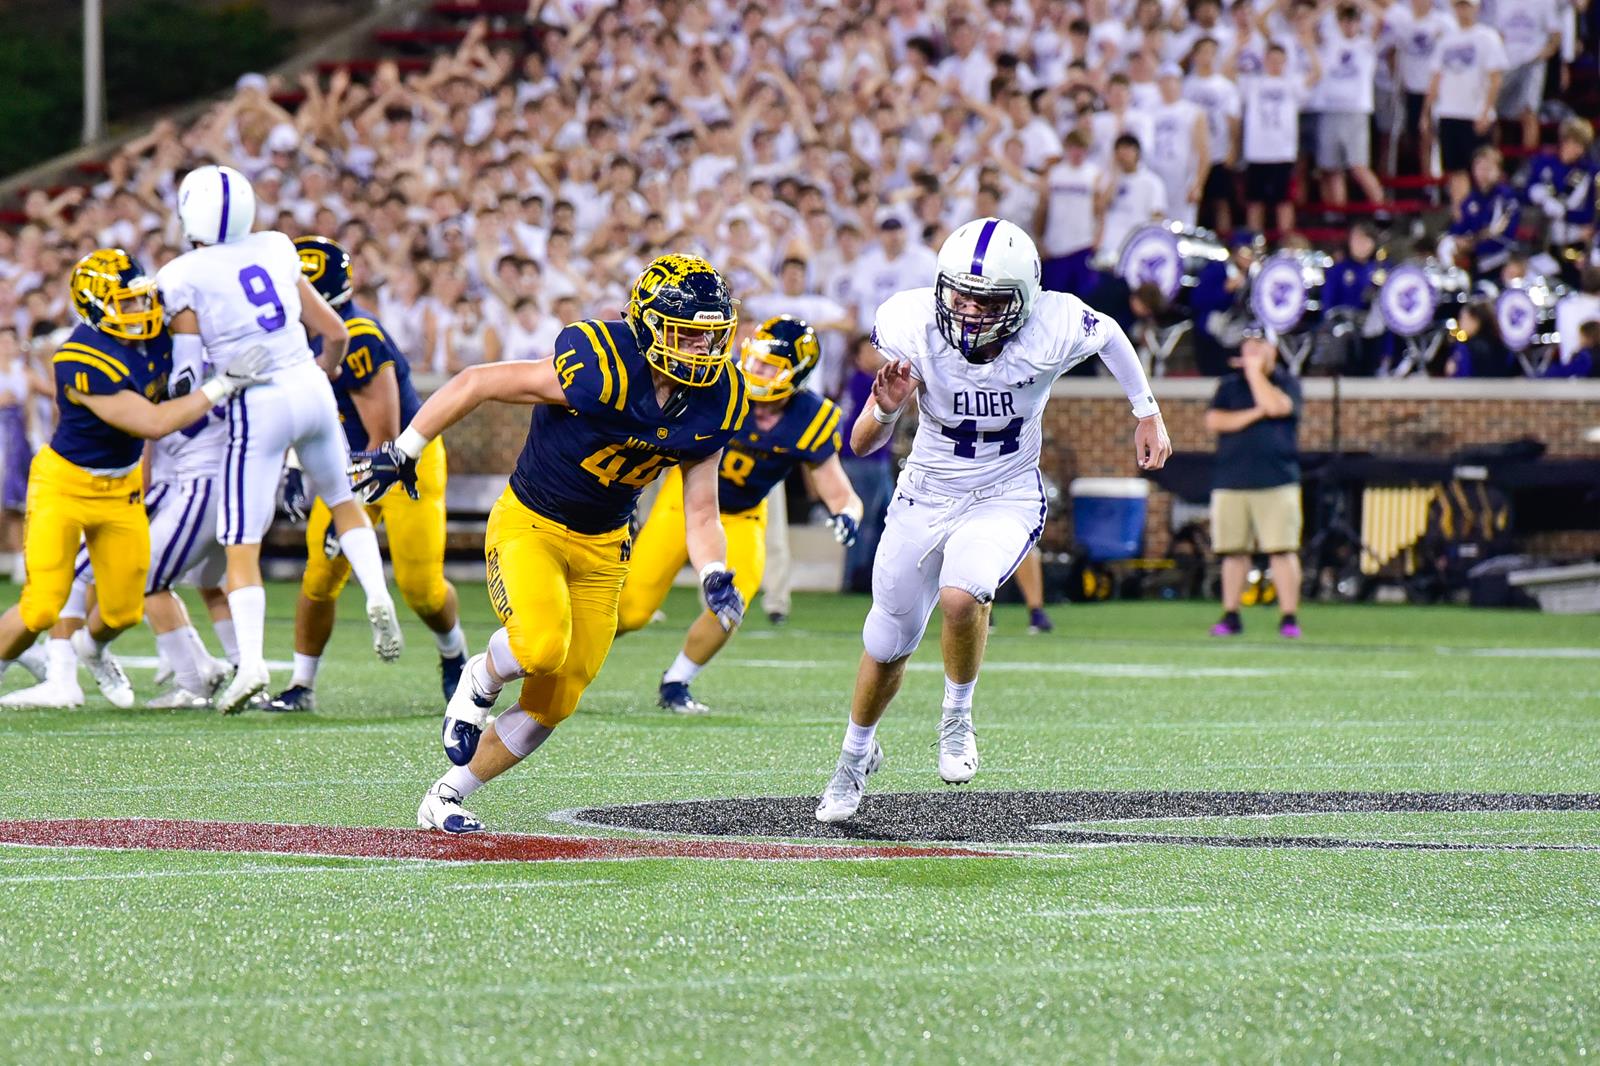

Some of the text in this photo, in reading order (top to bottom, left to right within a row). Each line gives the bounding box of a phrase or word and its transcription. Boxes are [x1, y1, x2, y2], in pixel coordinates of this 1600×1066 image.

[238, 264, 286, 333] 9
[346, 346, 373, 379] 97
[555, 348, 585, 390] 44
[953, 390, 1017, 417] ELDER
[940, 416, 1025, 459] 44
[579, 443, 680, 490] 44
